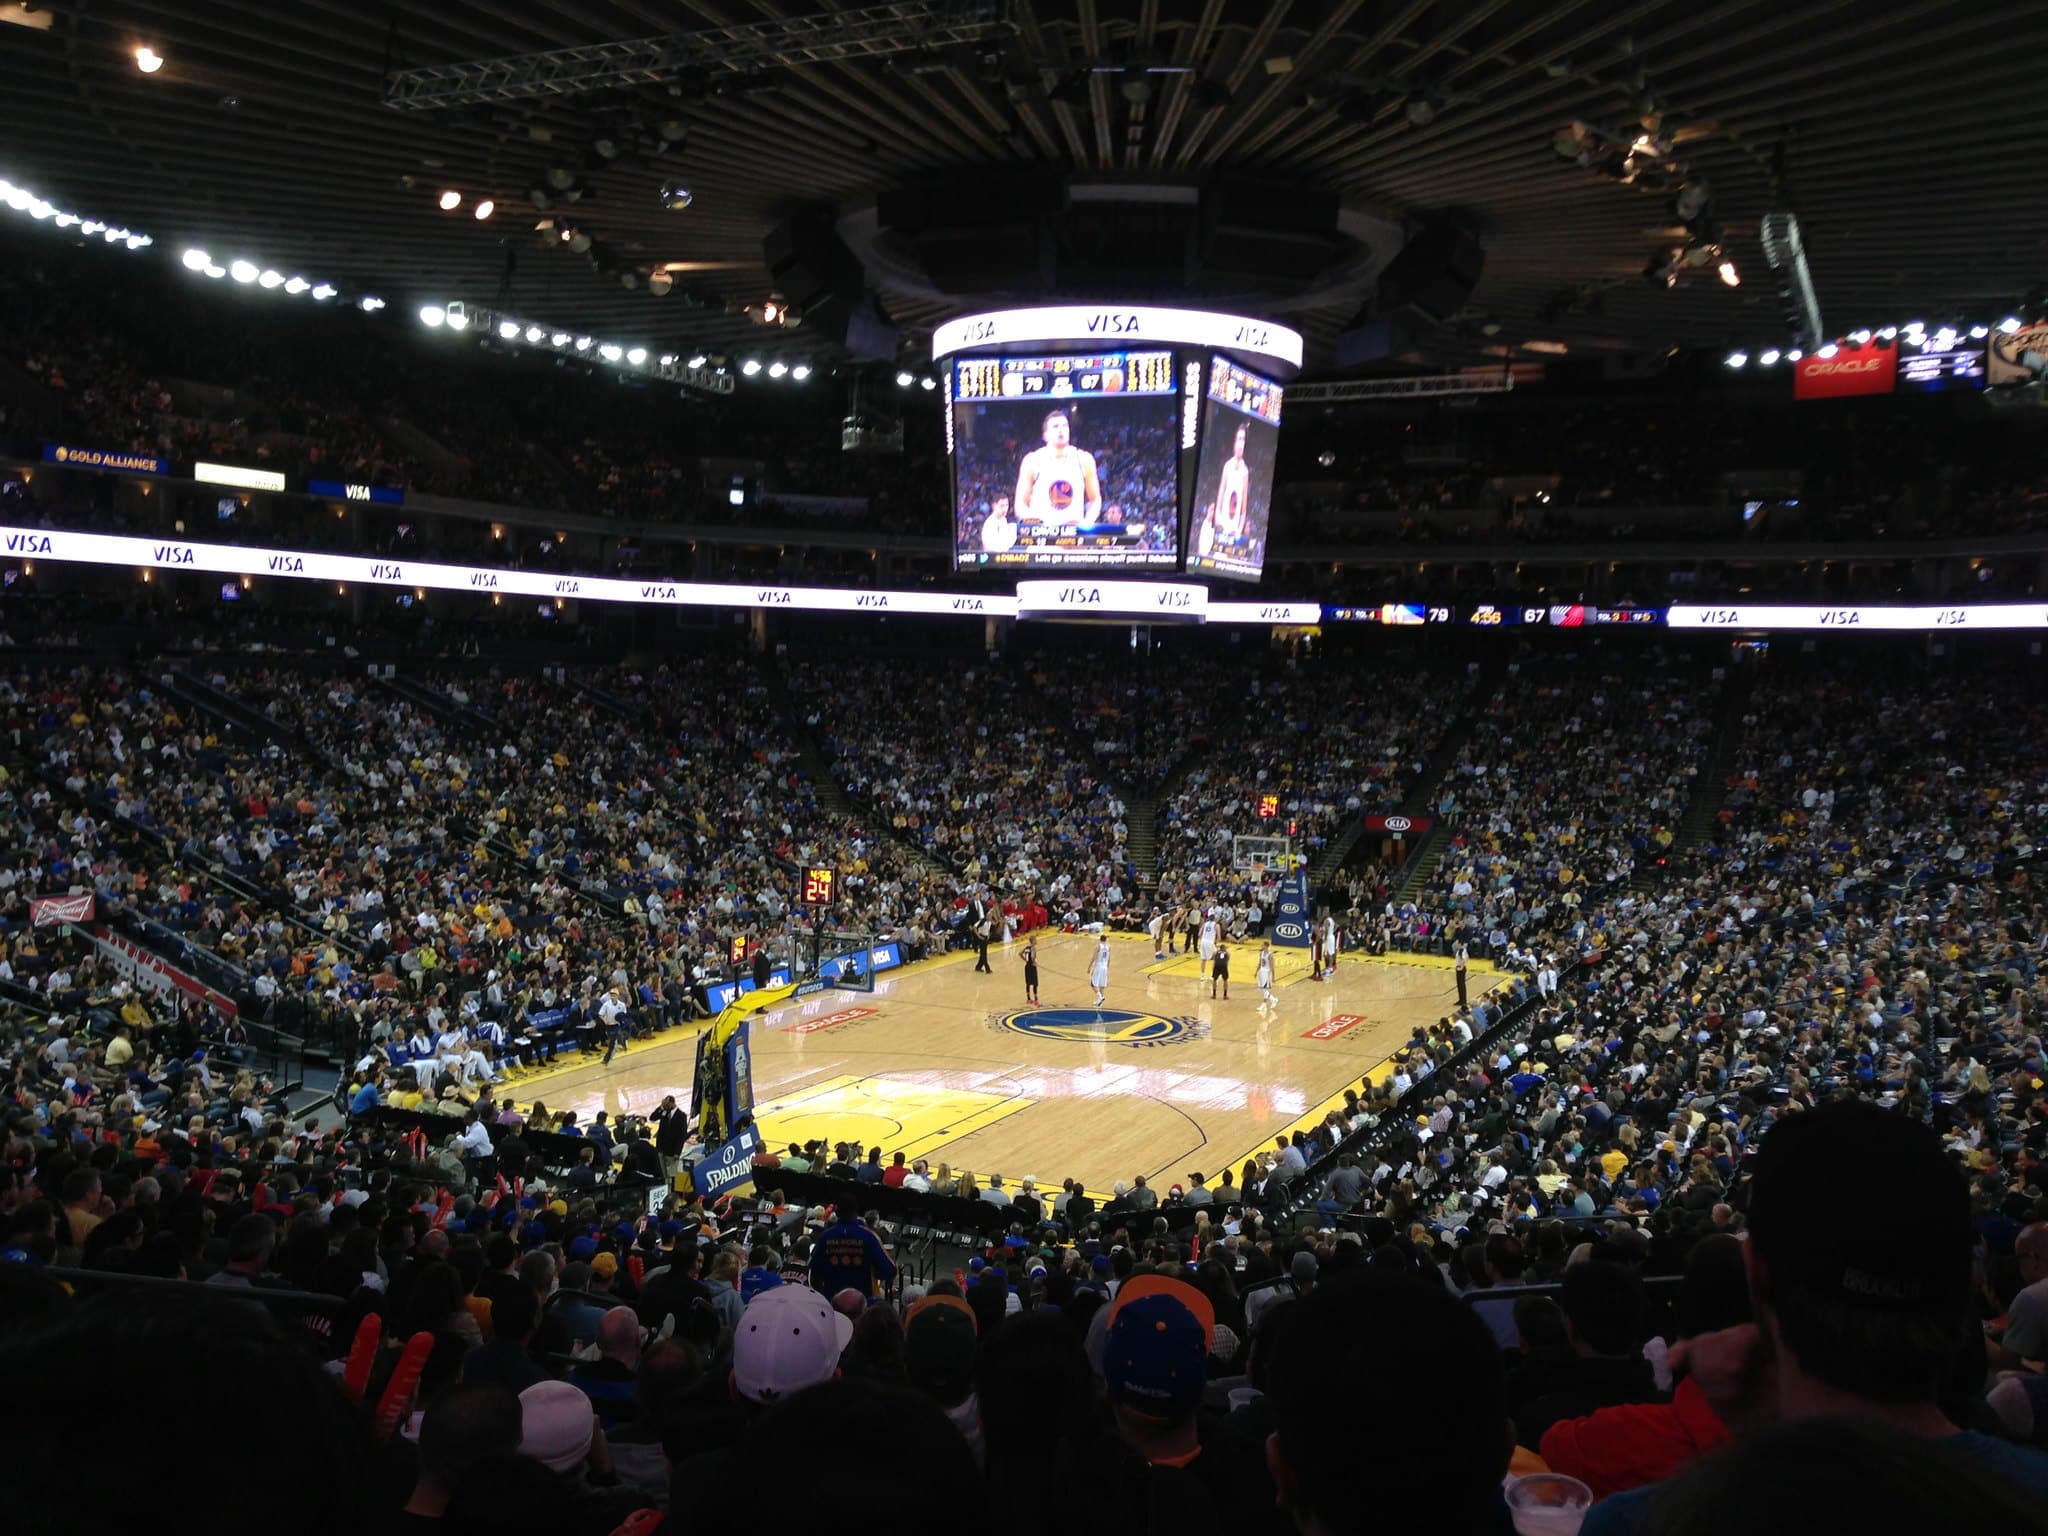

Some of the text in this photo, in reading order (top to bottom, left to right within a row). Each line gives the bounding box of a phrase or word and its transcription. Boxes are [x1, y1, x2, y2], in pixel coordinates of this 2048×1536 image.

[965, 321, 995, 341] VISA
[1087, 315, 1140, 333] VISA
[1235, 326, 1268, 346] VISA
[1804, 358, 1882, 377] ORACLE
[69, 450, 157, 472] GOLD ALLIANCE
[346, 484, 370, 501] VISA
[6, 534, 52, 553] VISA
[154, 546, 194, 564] VISA
[268, 556, 304, 573] VISA
[370, 564, 402, 580] VISA
[470, 573, 498, 587] VISA
[555, 581, 579, 593] VISA
[641, 587, 676, 599] VISA
[758, 591, 791, 603] VISA
[1059, 588, 1101, 603] VISA
[1158, 591, 1190, 606] VISA
[856, 596, 888, 607] VISA
[952, 599, 983, 610] VISA
[1260, 607, 1291, 619] VISA
[1429, 608, 1448, 622] 79
[1470, 611, 1501, 624] 4:56
[1524, 609, 1545, 623] 67
[1700, 610, 1738, 624] VISA
[1820, 611, 1860, 625] VISA
[1936, 611, 1966, 625] VISA
[1259, 803, 1276, 816] 24
[1387, 818, 1408, 829] KIA
[807, 881, 829, 902] 24
[1279, 926, 1299, 936] KIA
[733, 948, 744, 961] 24
[872, 949, 891, 965] VISA
[797, 1009, 868, 1031] ORACLE
[1311, 1014, 1357, 1039] ORACLE
[653, 1189, 665, 1200] SEC
